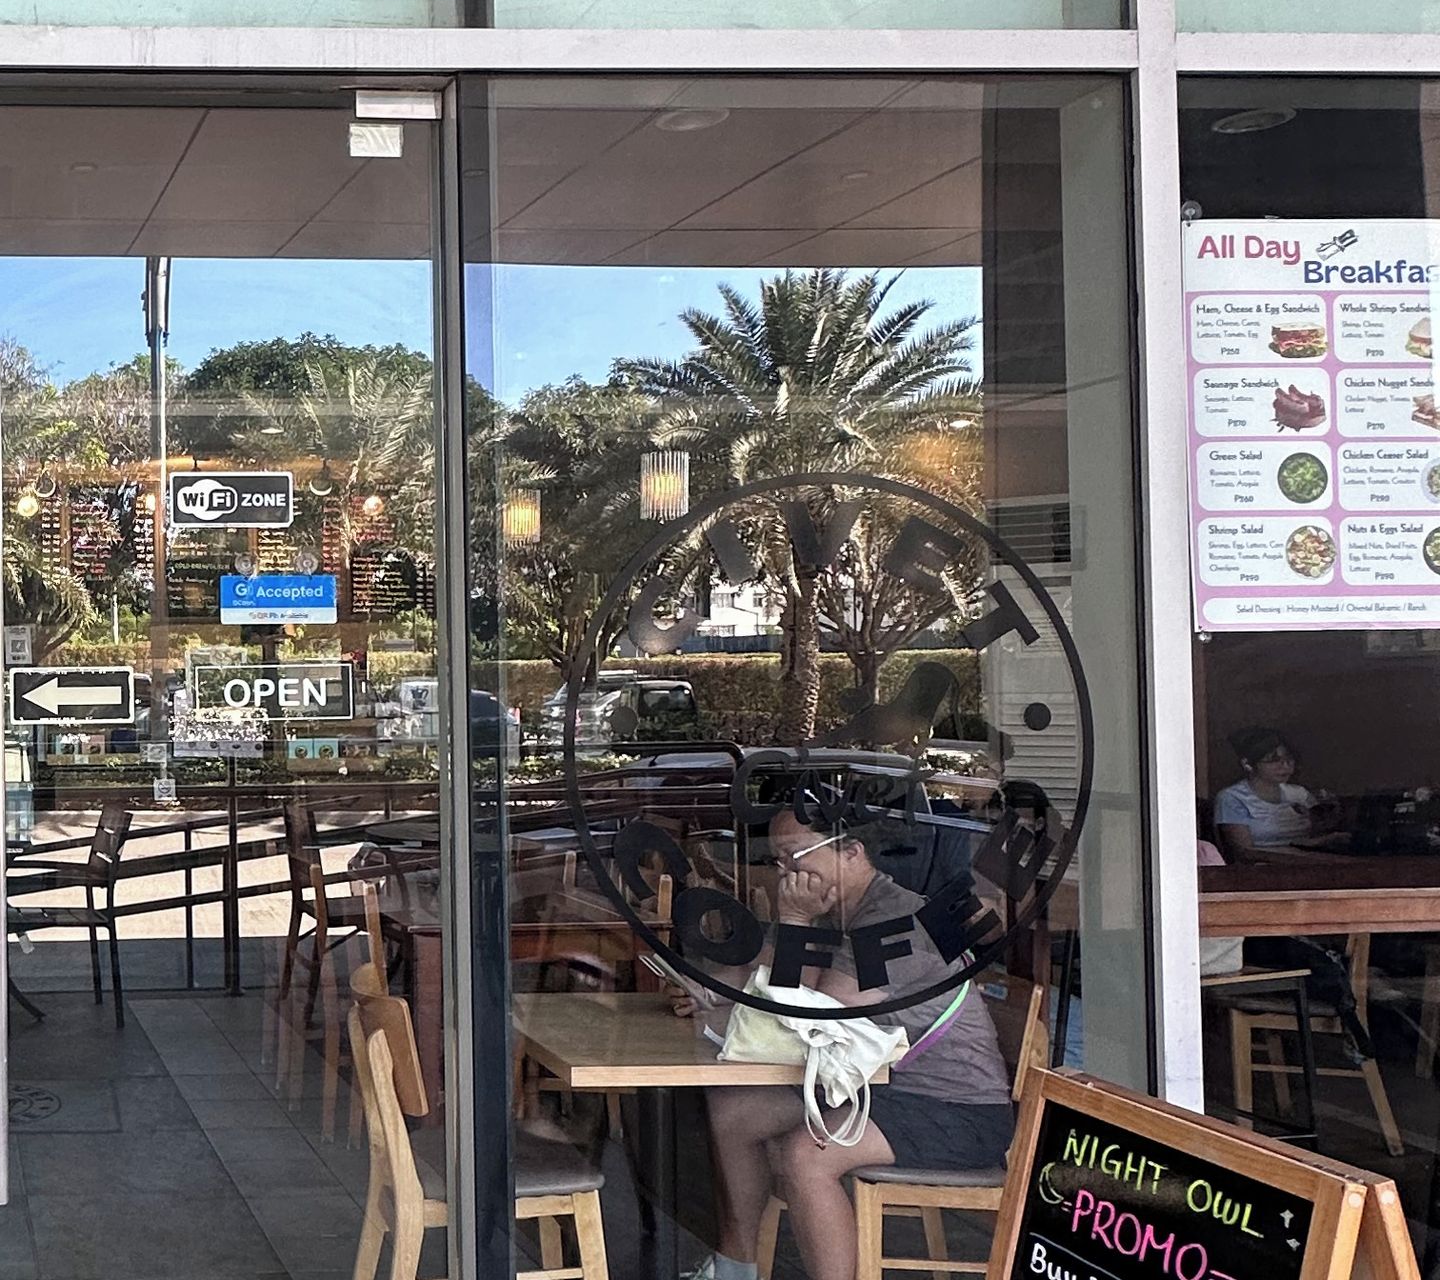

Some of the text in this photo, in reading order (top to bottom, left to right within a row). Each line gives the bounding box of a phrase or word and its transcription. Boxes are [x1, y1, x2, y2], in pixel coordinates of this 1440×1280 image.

[1197, 235, 1301, 265] All Day
[1304, 260, 1434, 283] Breakfas
[241, 493, 286, 507] ZONE
[256, 586, 323, 601] Accepted
[223, 678, 327, 707] OPEN
[1063, 1129, 1264, 1238] NIGHT OWL
